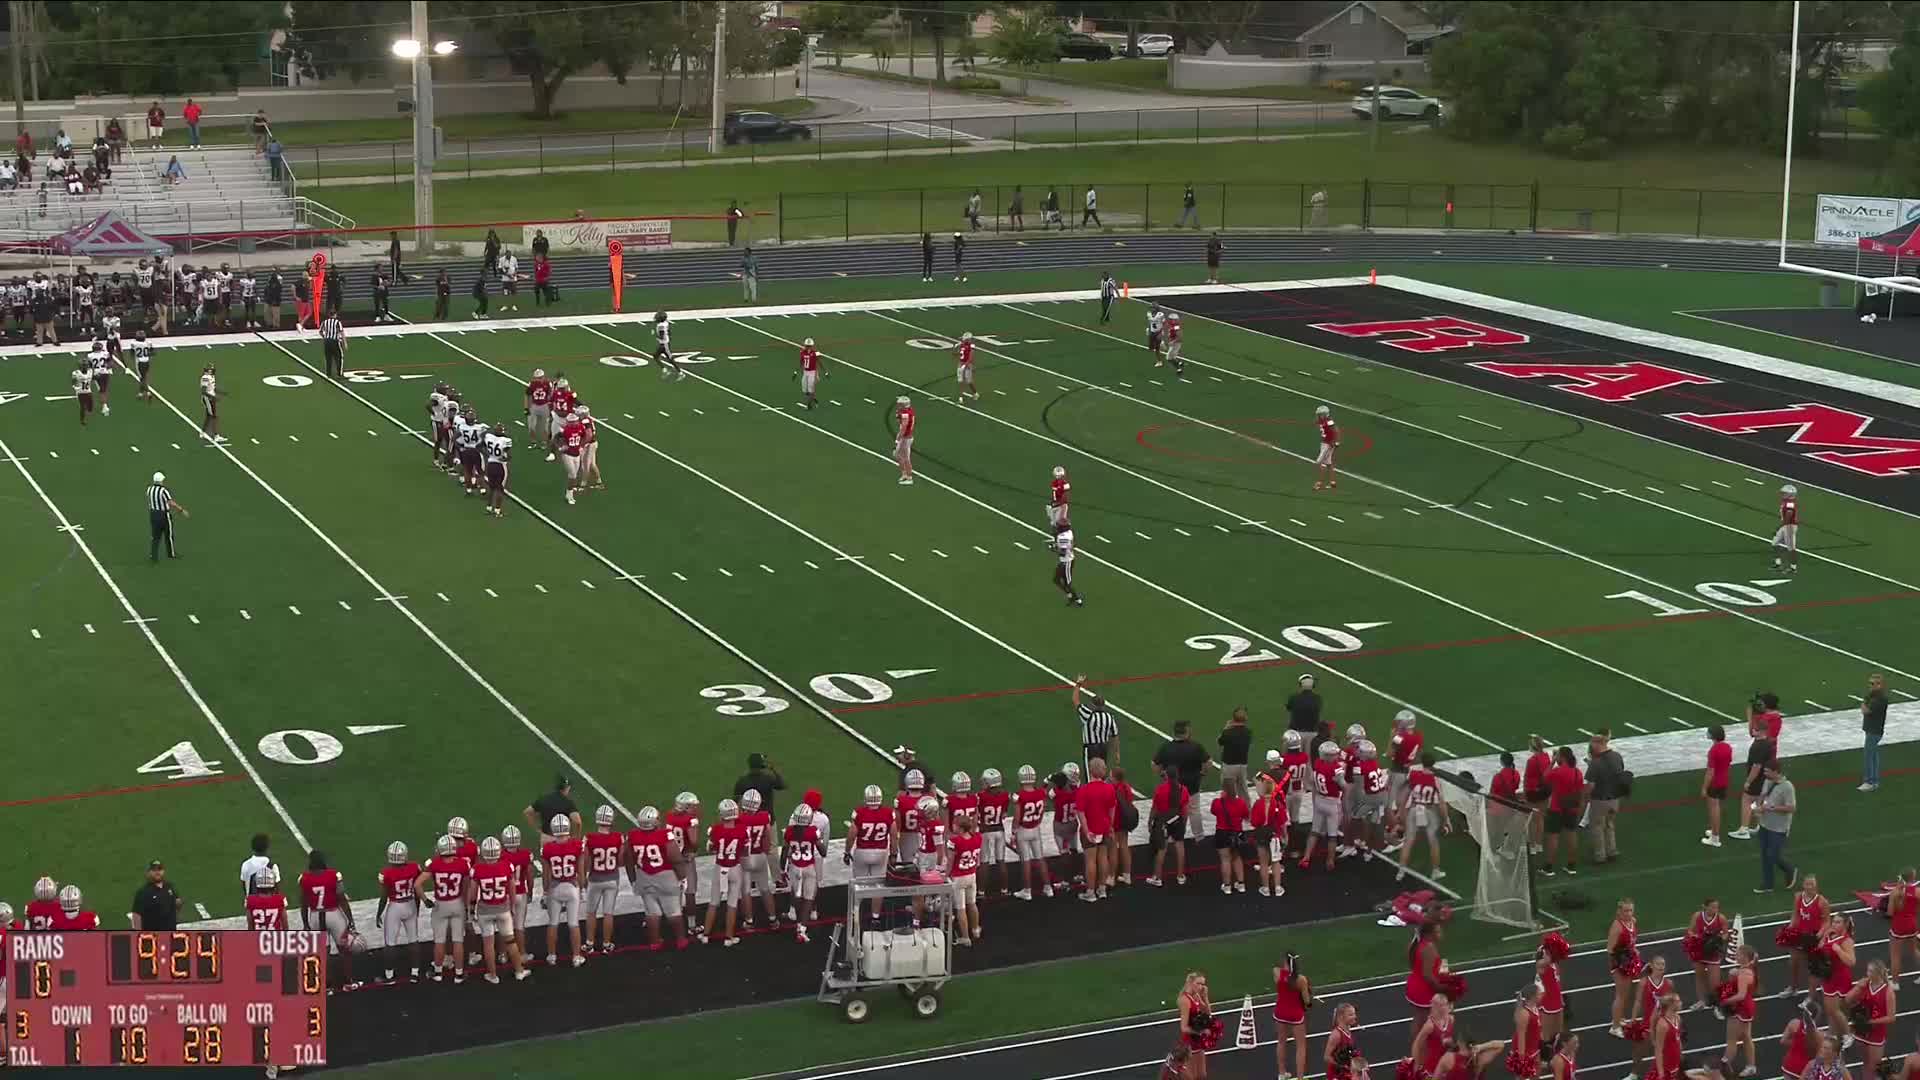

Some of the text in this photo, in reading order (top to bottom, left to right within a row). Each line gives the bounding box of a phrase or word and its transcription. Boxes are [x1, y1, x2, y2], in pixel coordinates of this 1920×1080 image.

[1821, 206, 1895, 217] PINNACLE
[561, 223, 605, 248] Kelly
[136, 347, 150, 358] 20
[462, 429, 479, 444] 54
[486, 441, 502, 457] 56
[983, 805, 1003, 826] 21
[861, 822, 888, 842] 72
[593, 847, 618, 872] 26
[633, 844, 664, 868] 79
[717, 838, 739, 860] 14
[550, 854, 577, 879] 66
[435, 872, 462, 898] 53
[480, 876, 508, 901] 55
[312, 885, 326, 910] 7
[1239, 1009, 1254, 1046] RAMS
